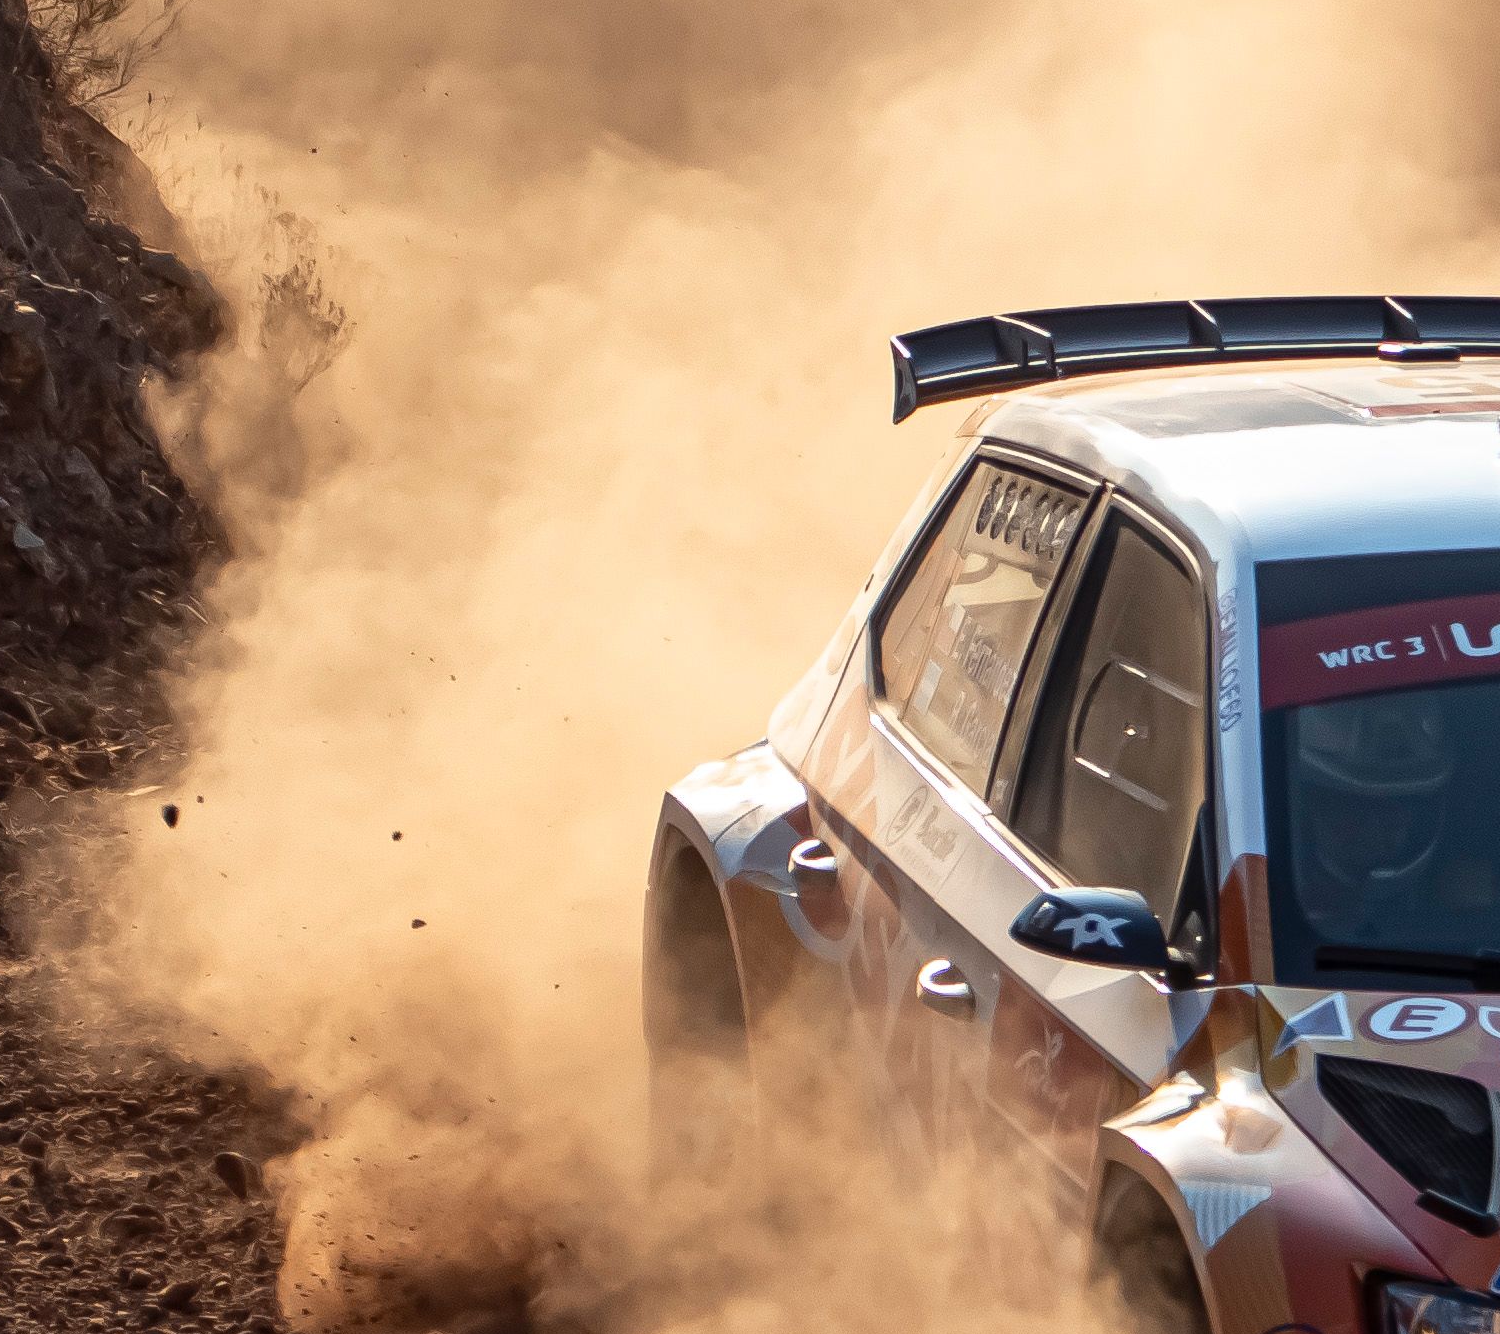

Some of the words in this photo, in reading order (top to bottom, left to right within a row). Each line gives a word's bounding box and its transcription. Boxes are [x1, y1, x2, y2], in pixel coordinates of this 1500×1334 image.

[1318, 640, 1396, 669] WRC
[1403, 636, 1426, 657] 3
[1389, 1003, 1445, 1033] E
